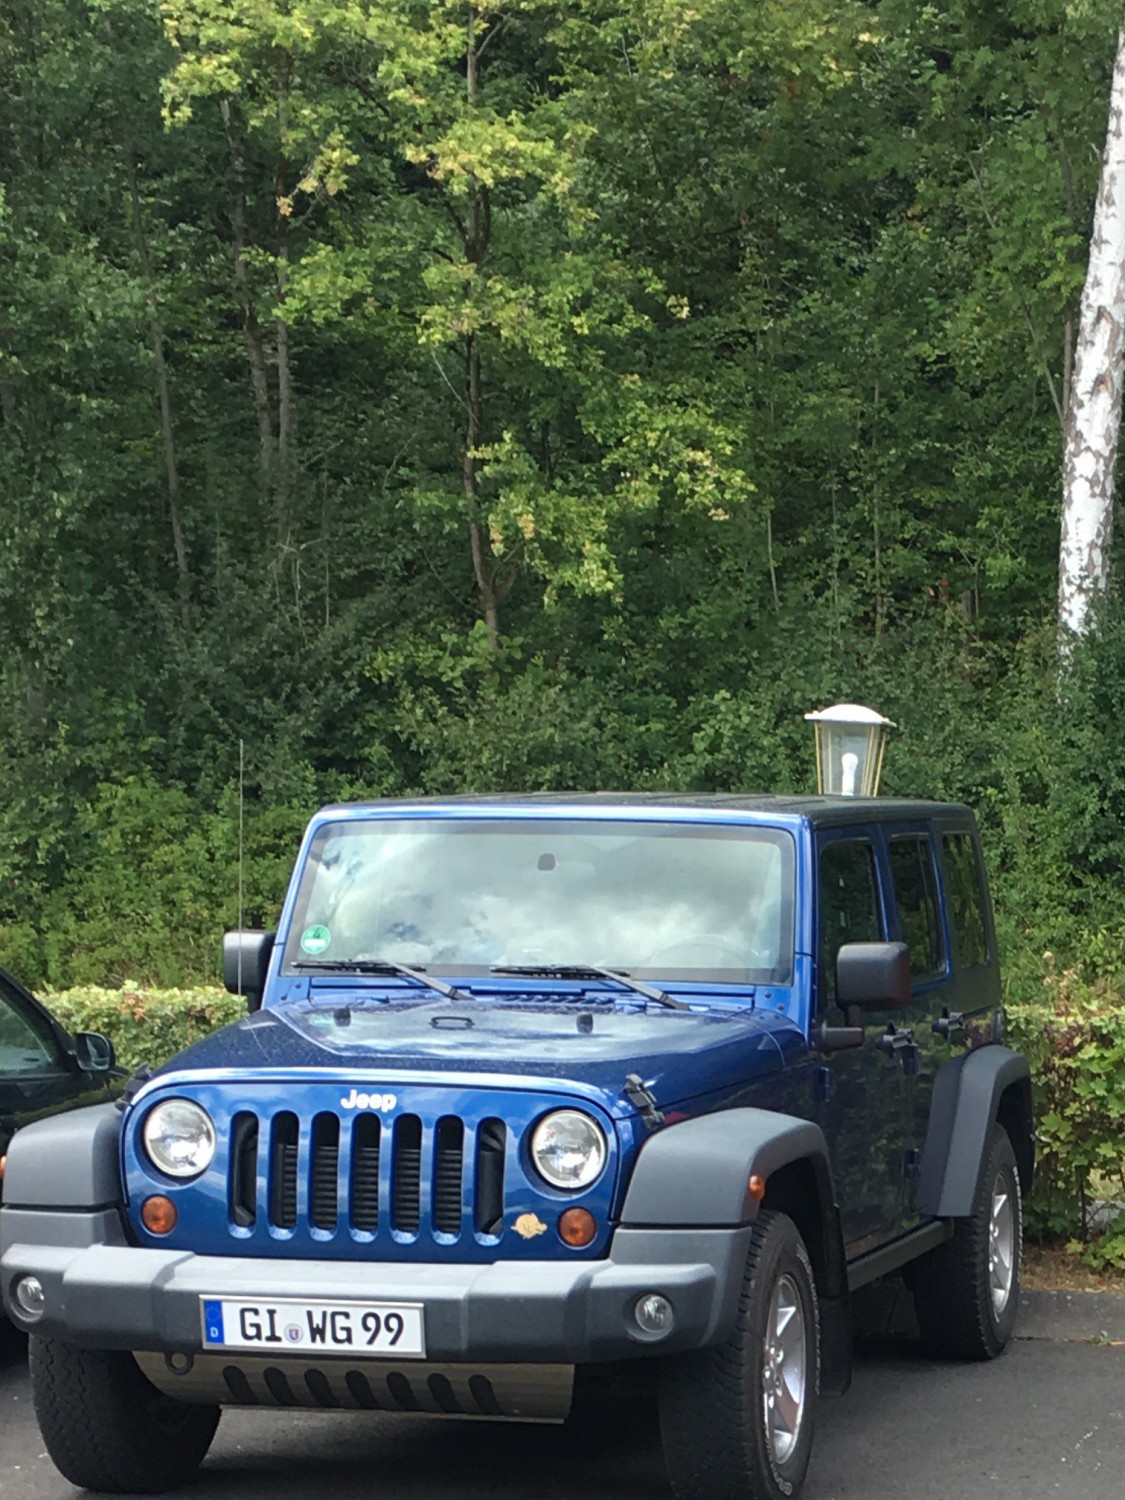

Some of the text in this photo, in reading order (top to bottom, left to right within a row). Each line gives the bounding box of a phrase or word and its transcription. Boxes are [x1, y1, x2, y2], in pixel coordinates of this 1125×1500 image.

[340, 1089, 397, 1113] Jeep
[210, 1307, 405, 1346] D GI WG 99
